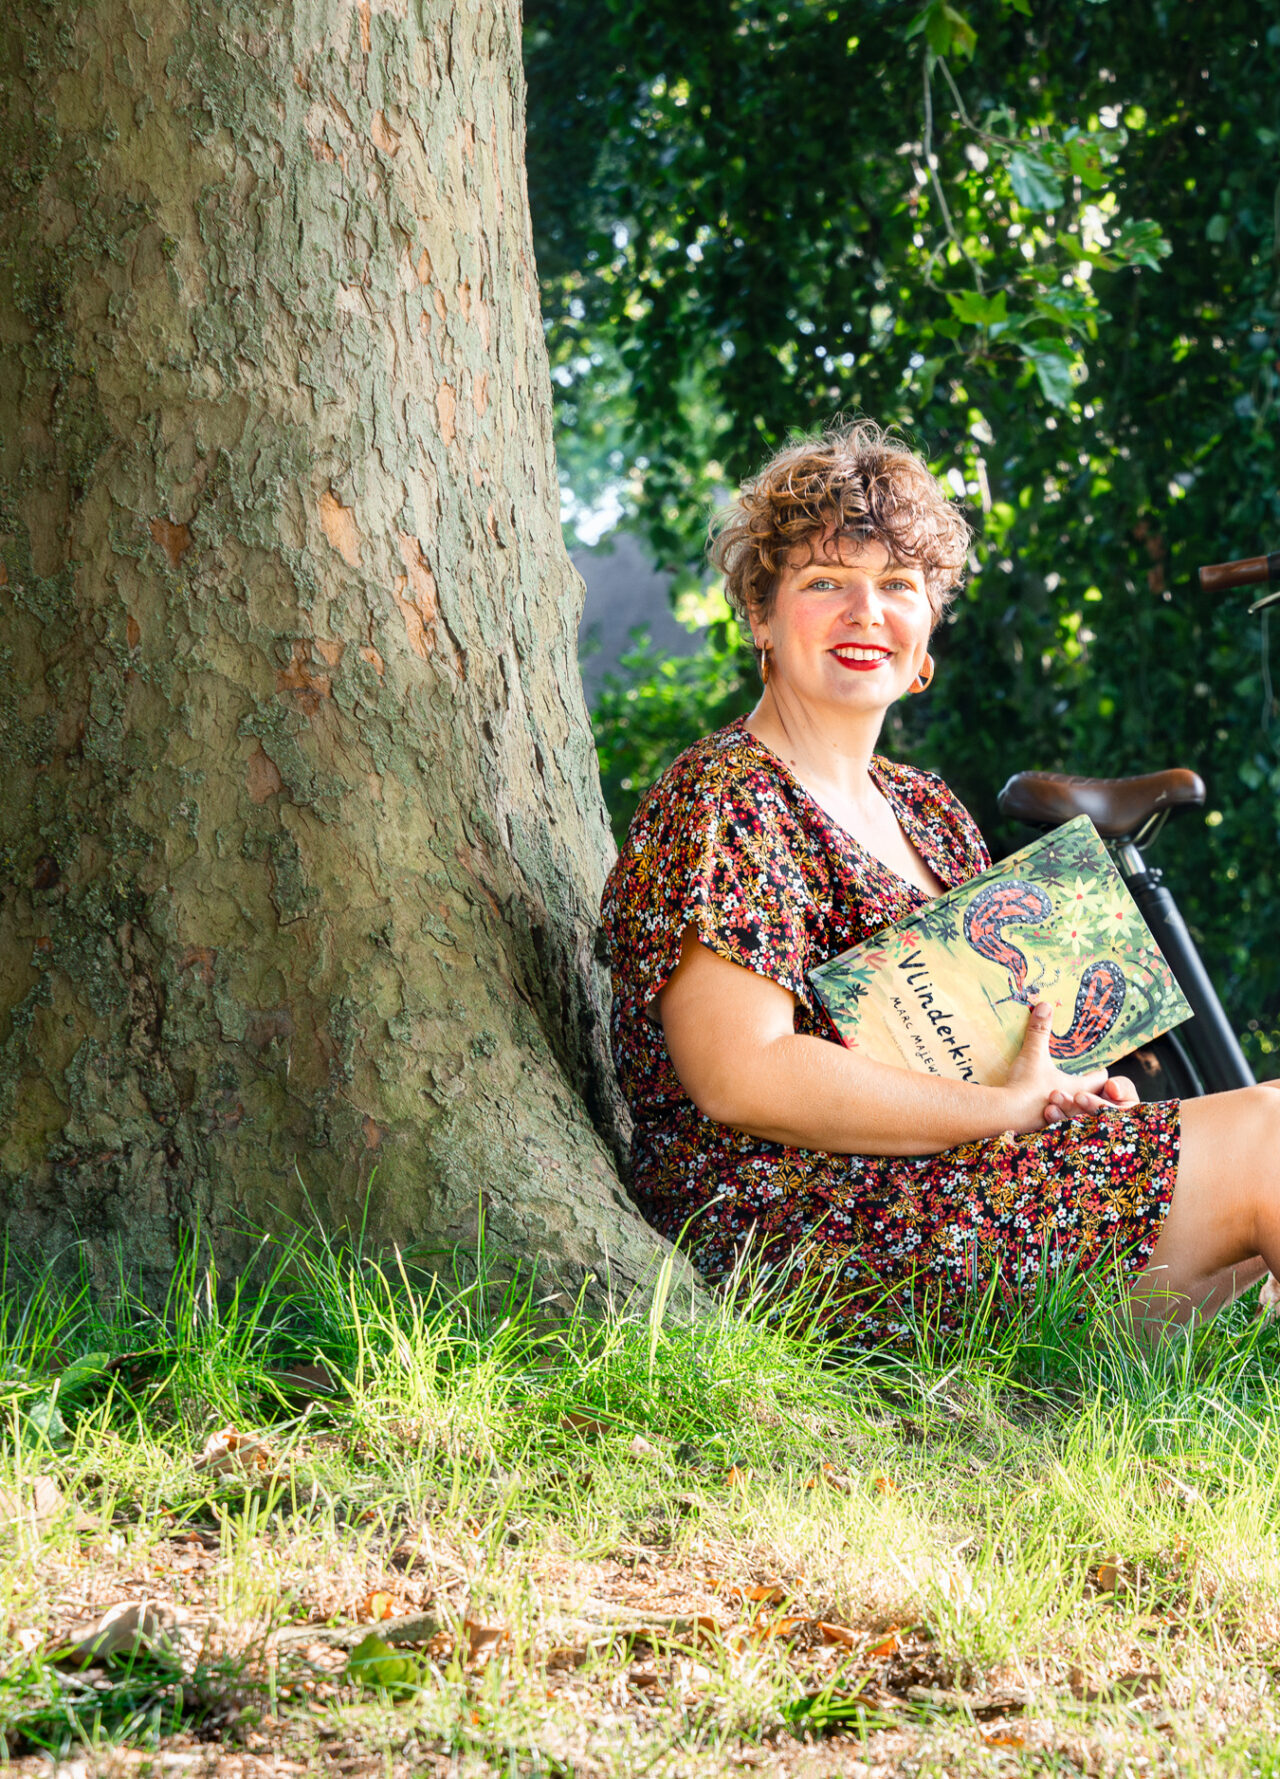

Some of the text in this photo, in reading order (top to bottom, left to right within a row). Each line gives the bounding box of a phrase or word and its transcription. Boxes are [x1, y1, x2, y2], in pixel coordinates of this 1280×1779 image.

[890, 997, 913, 1030] MARC
[911, 1034, 941, 1077] MAJEW
[898, 950, 980, 1084] Vlinderkin
